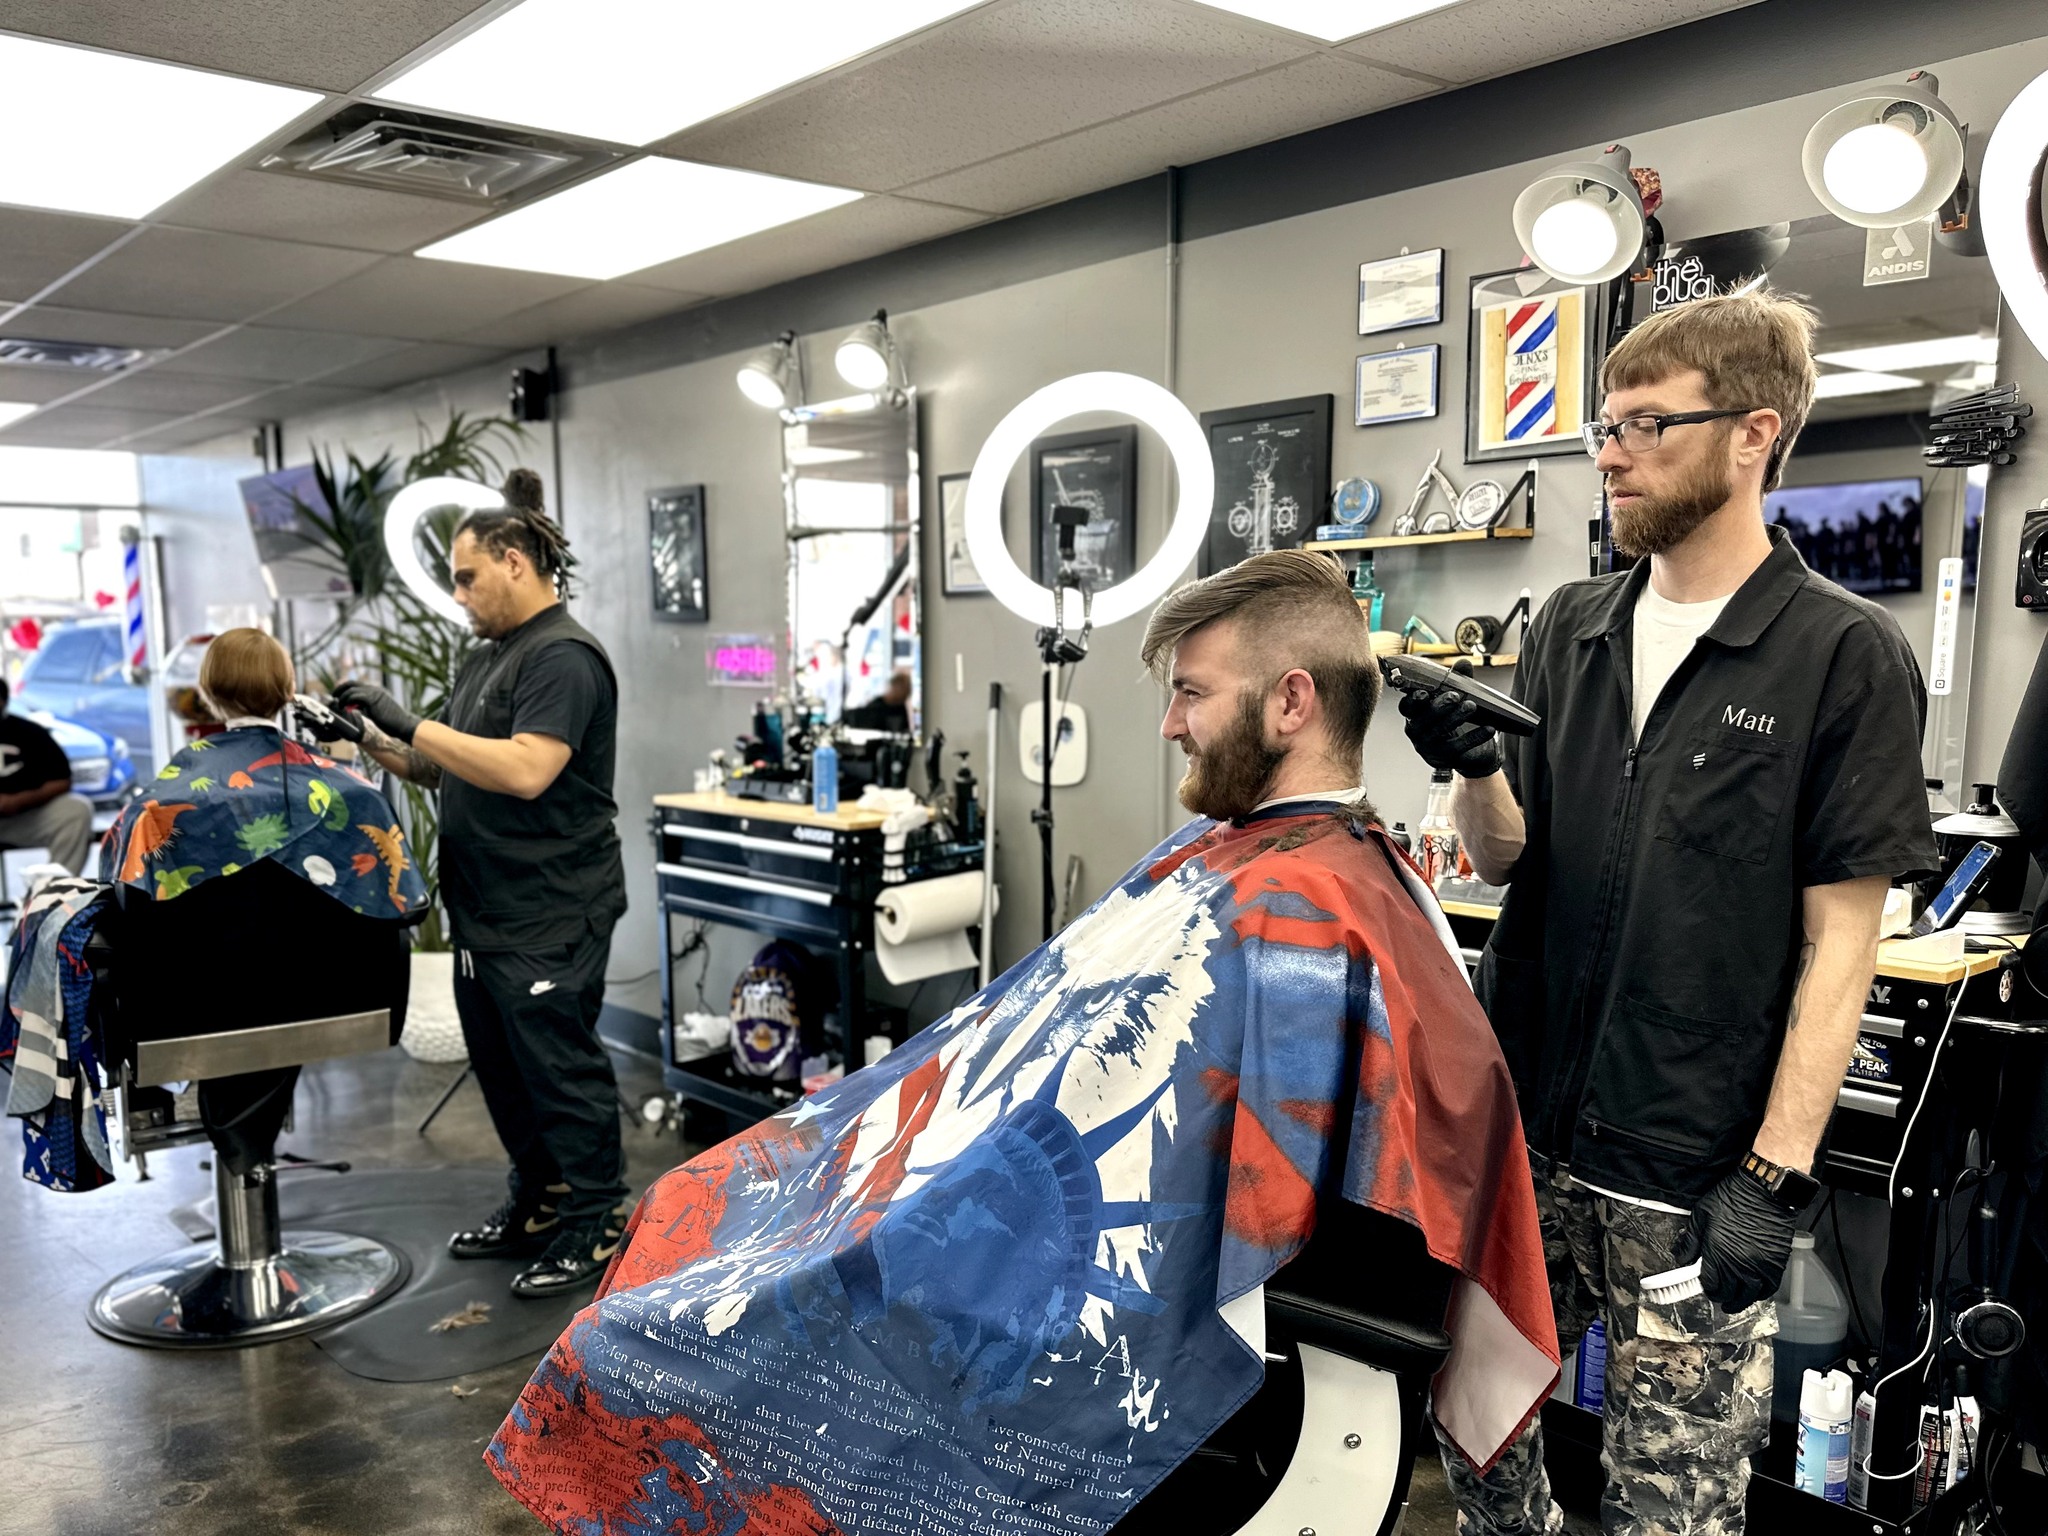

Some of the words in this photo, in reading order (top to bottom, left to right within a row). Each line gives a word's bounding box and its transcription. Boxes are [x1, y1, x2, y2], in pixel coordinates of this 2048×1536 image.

[1867, 260, 1925, 278] ANDIS
[1937, 653, 1947, 677] Square
[1721, 704, 1776, 735] Matt
[1859, 1036, 1871, 1044] ON
[1872, 1040, 1887, 1050] TOP
[1859, 1058, 1889, 1074] PEAK
[649, 1310, 666, 1327] the
[724, 1344, 747, 1360] and
[849, 1391, 862, 1403] to
[873, 1398, 914, 1421] which
[926, 1413, 946, 1431] the
[731, 1329, 743, 1340] to
[834, 1359, 886, 1393] Political
[630, 1320, 642, 1332] of
[700, 1350, 748, 1379] requires
[786, 1380, 816, 1400] they
[859, 1410, 907, 1434] declare
[983, 1454, 1026, 1478] which
[1034, 1468, 1075, 1490] impel
[598, 1363, 621, 1379] and
[624, 1372, 645, 1390] the
[694, 1402, 711, 1415] of
[833, 1457, 846, 1470] to
[933, 1486, 982, 1518] Rights,
[633, 1358, 652, 1373] are
[654, 1367, 697, 1393] created
[755, 1404, 782, 1422] that
[845, 1444, 905, 1468] endowed
[913, 1459, 931, 1475] by
[937, 1472, 970, 1493] their
[974, 1485, 1027, 1509] Creator
[1030, 1502, 1061, 1520] with
[1015, 1431, 1086, 1460] connected
[645, 1400, 670, 1415] that
[740, 1434, 761, 1452] any
[767, 1440, 802, 1466] Form
[807, 1461, 822, 1474] of
[822, 1467, 905, 1501] Government
[910, 1492, 964, 1526] becomes
[762, 1456, 778, 1472] its
[787, 1465, 855, 1508] Foundation
[861, 1501, 877, 1512] on
[994, 1440, 1013, 1453] of
[1017, 1445, 1067, 1471] Nature
[1074, 1467, 1101, 1480] and
[1108, 1471, 1126, 1484] of
[830, 1510, 857, 1526] will
